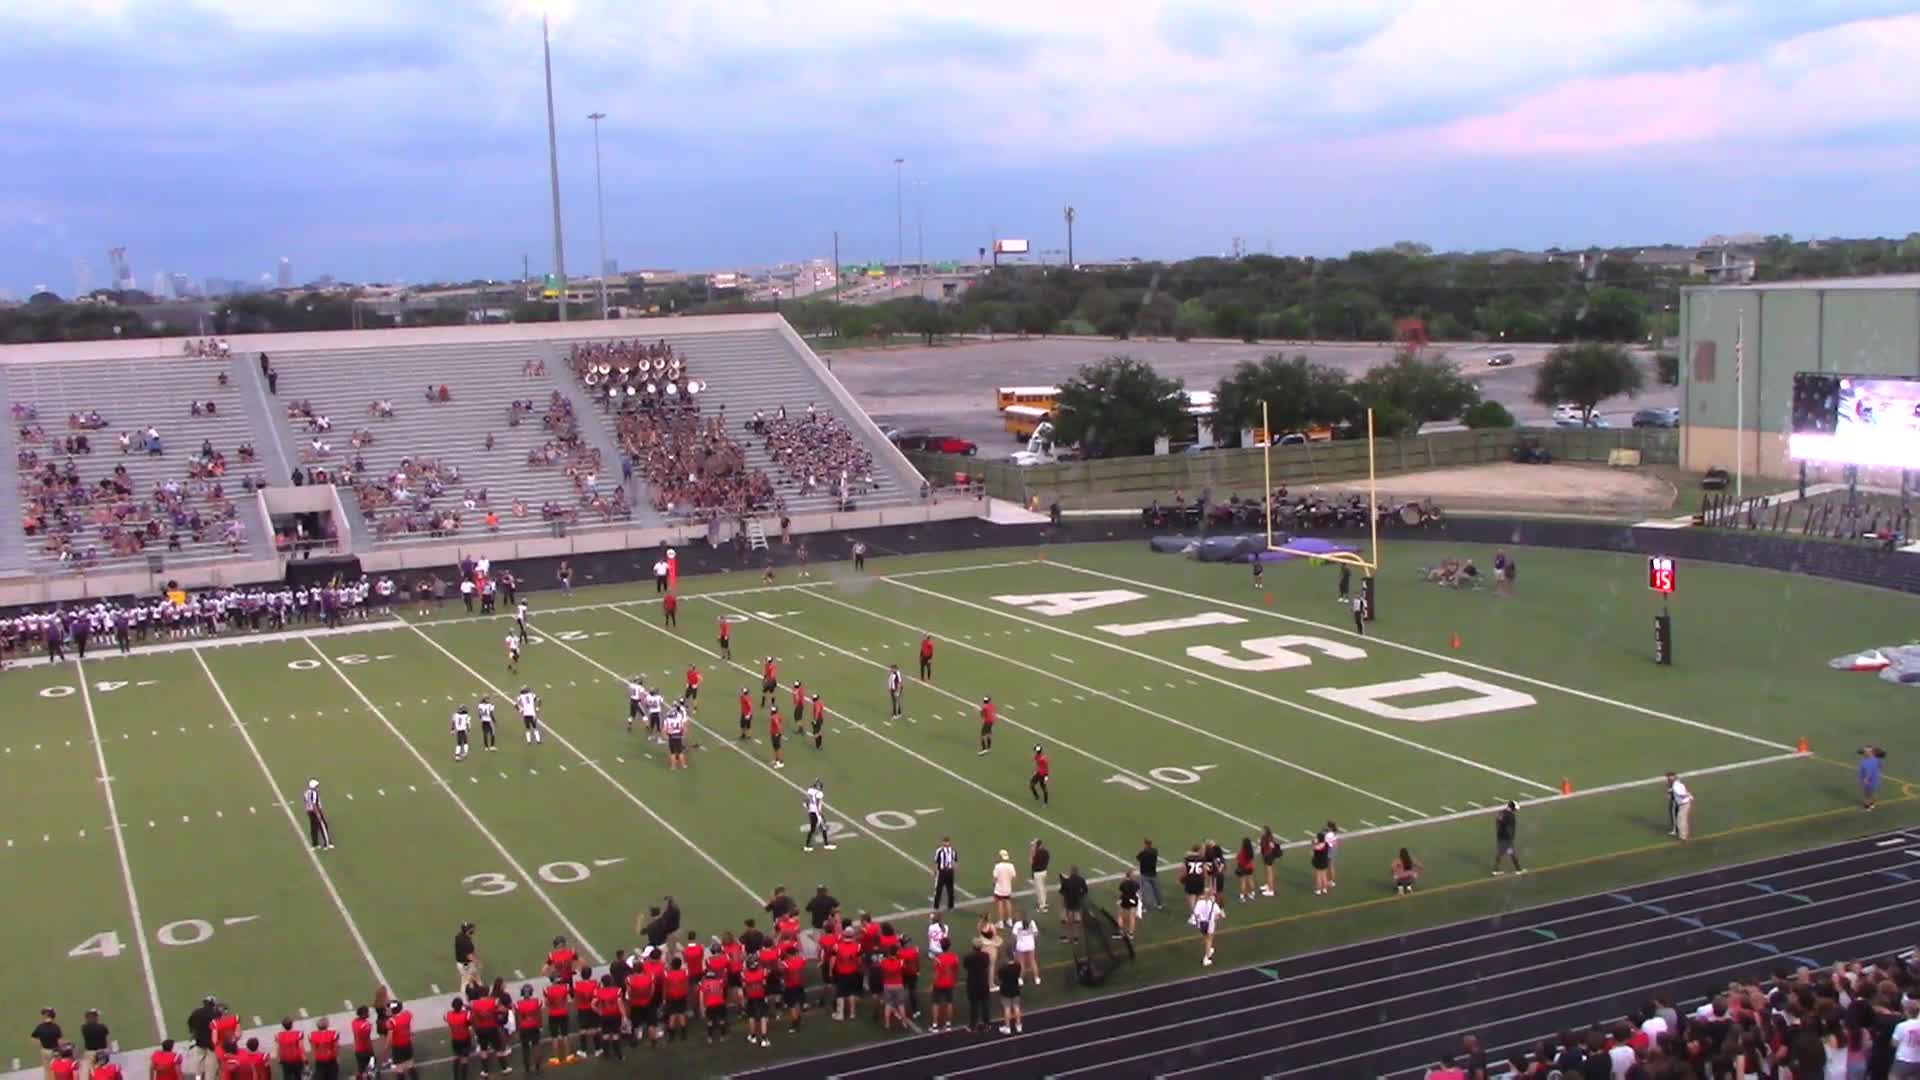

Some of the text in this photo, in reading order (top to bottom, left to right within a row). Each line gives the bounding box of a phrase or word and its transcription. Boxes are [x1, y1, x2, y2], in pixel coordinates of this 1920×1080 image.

[1656, 571, 1671, 589] 15
[990, 588, 1538, 722] AISD
[39, 681, 129, 698] 40
[1102, 766, 1201, 791] 10
[800, 810, 918, 843] 20
[461, 860, 592, 897] 30
[1187, 861, 1204, 875] 76
[68, 918, 215, 957] 40
